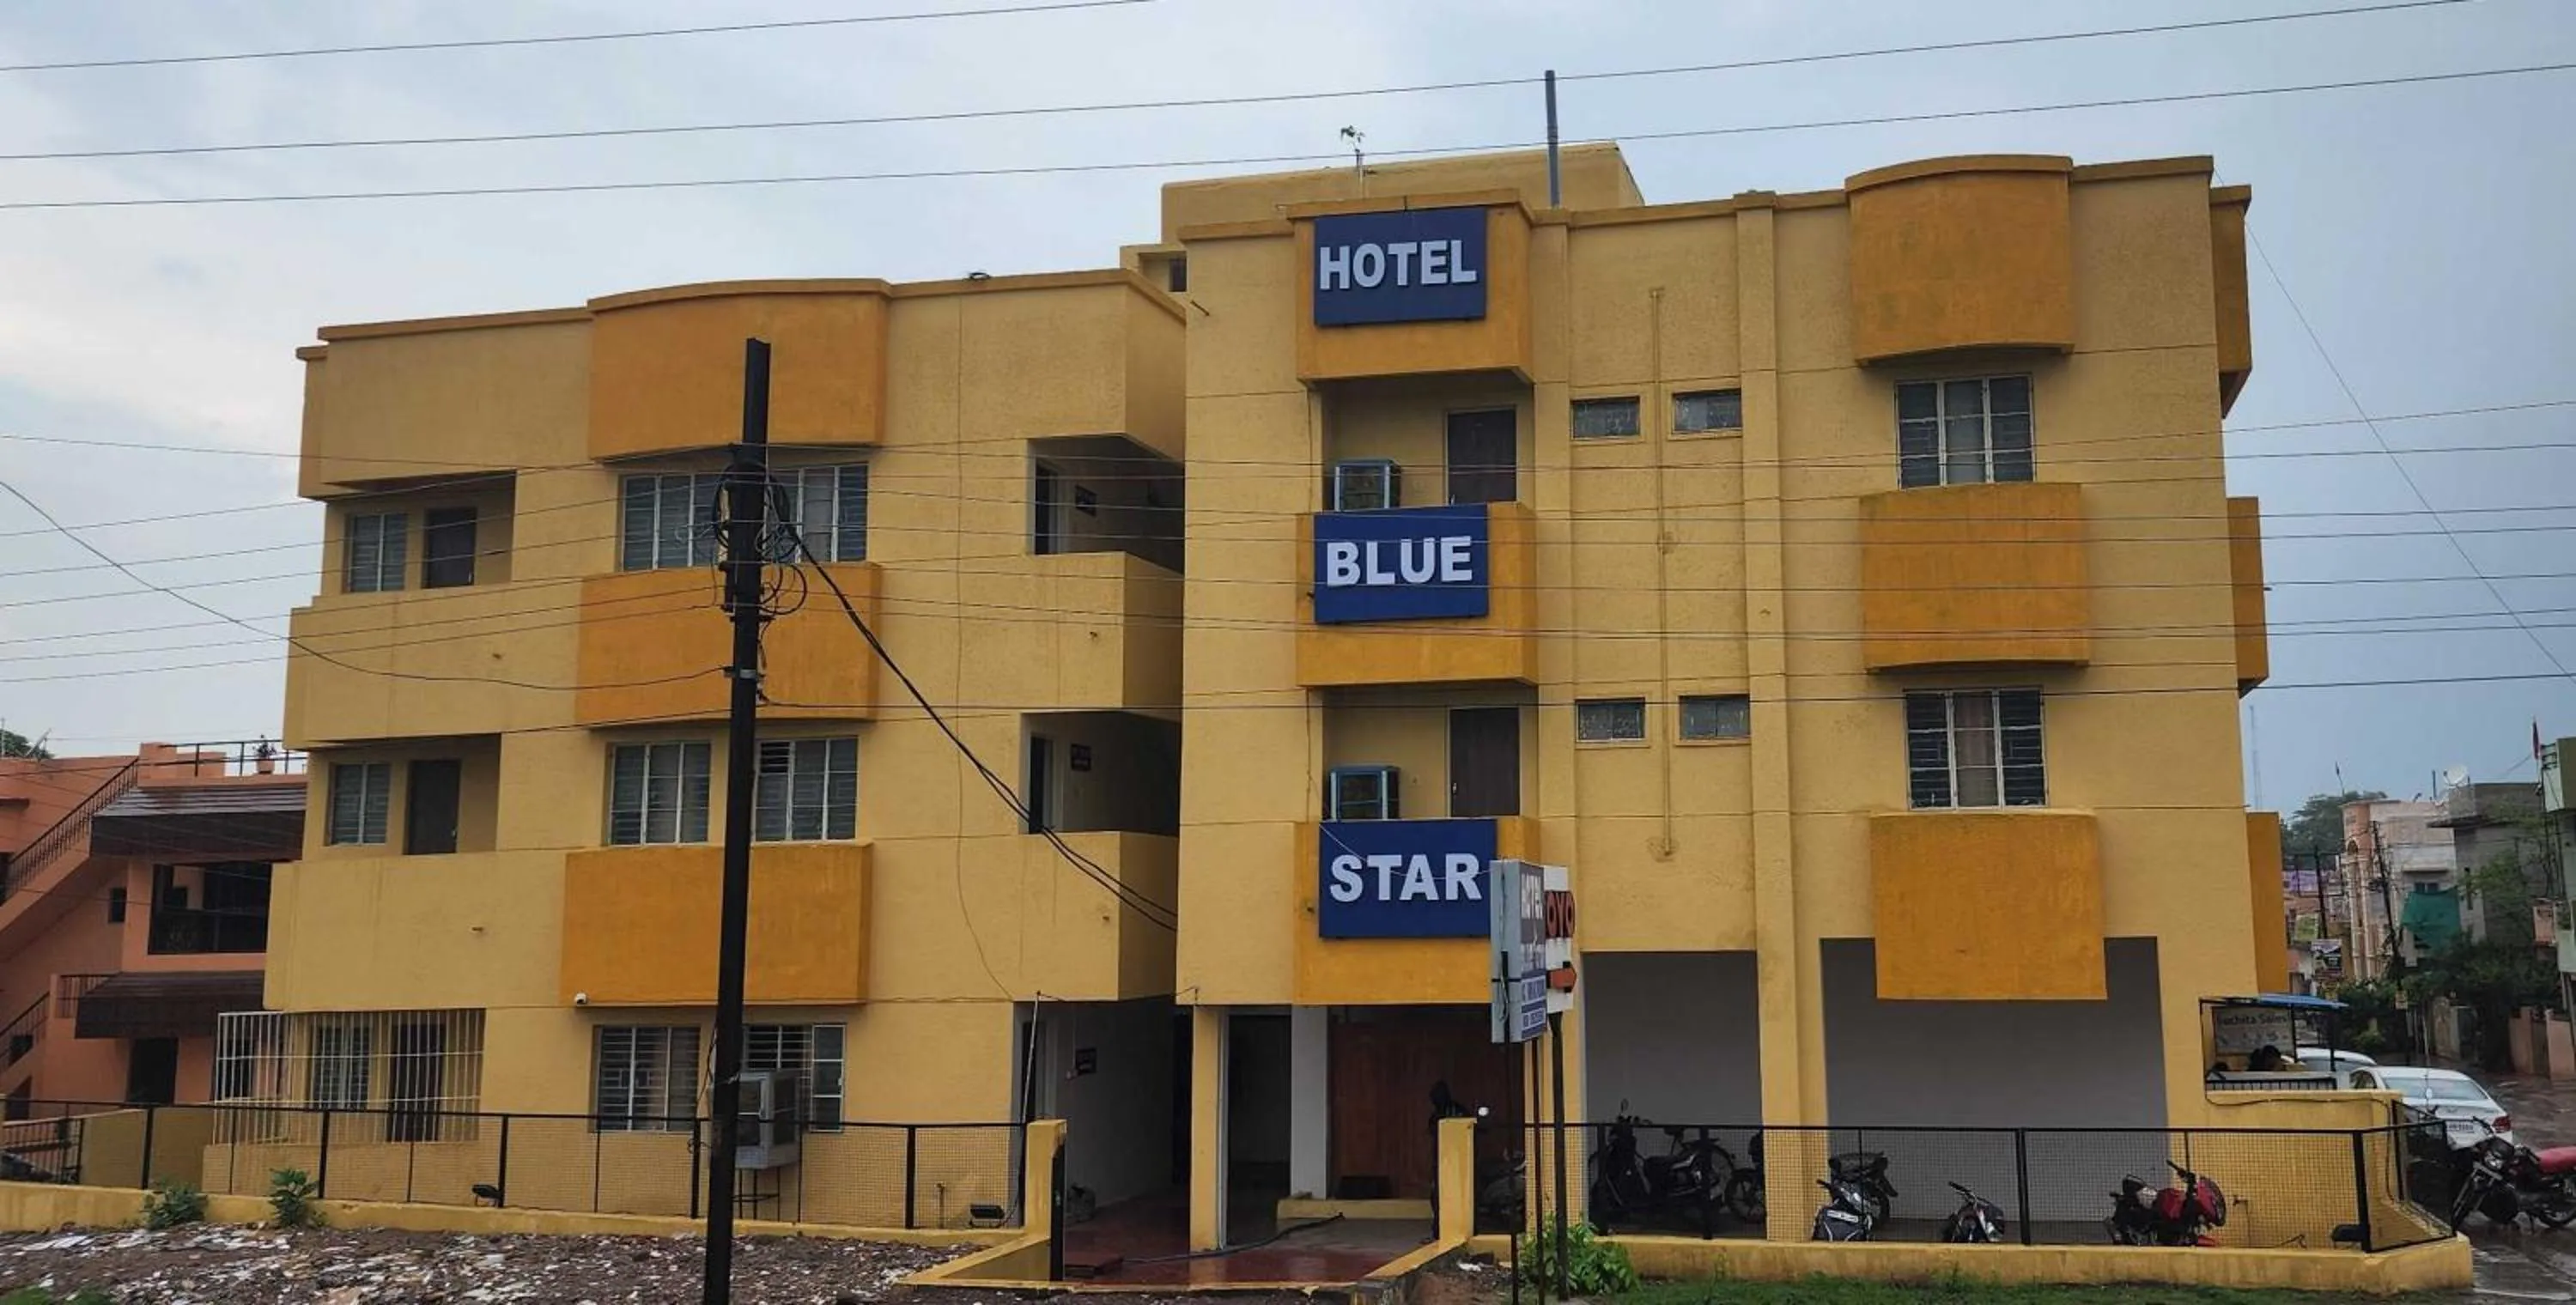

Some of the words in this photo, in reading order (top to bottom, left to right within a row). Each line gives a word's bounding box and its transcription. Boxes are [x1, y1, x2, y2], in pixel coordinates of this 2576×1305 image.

[1321, 240, 1477, 290] HOTEL
[1327, 536, 1473, 586] BLUE
[1330, 853, 1482, 902] STAR
[1547, 891, 1576, 938] OYO
